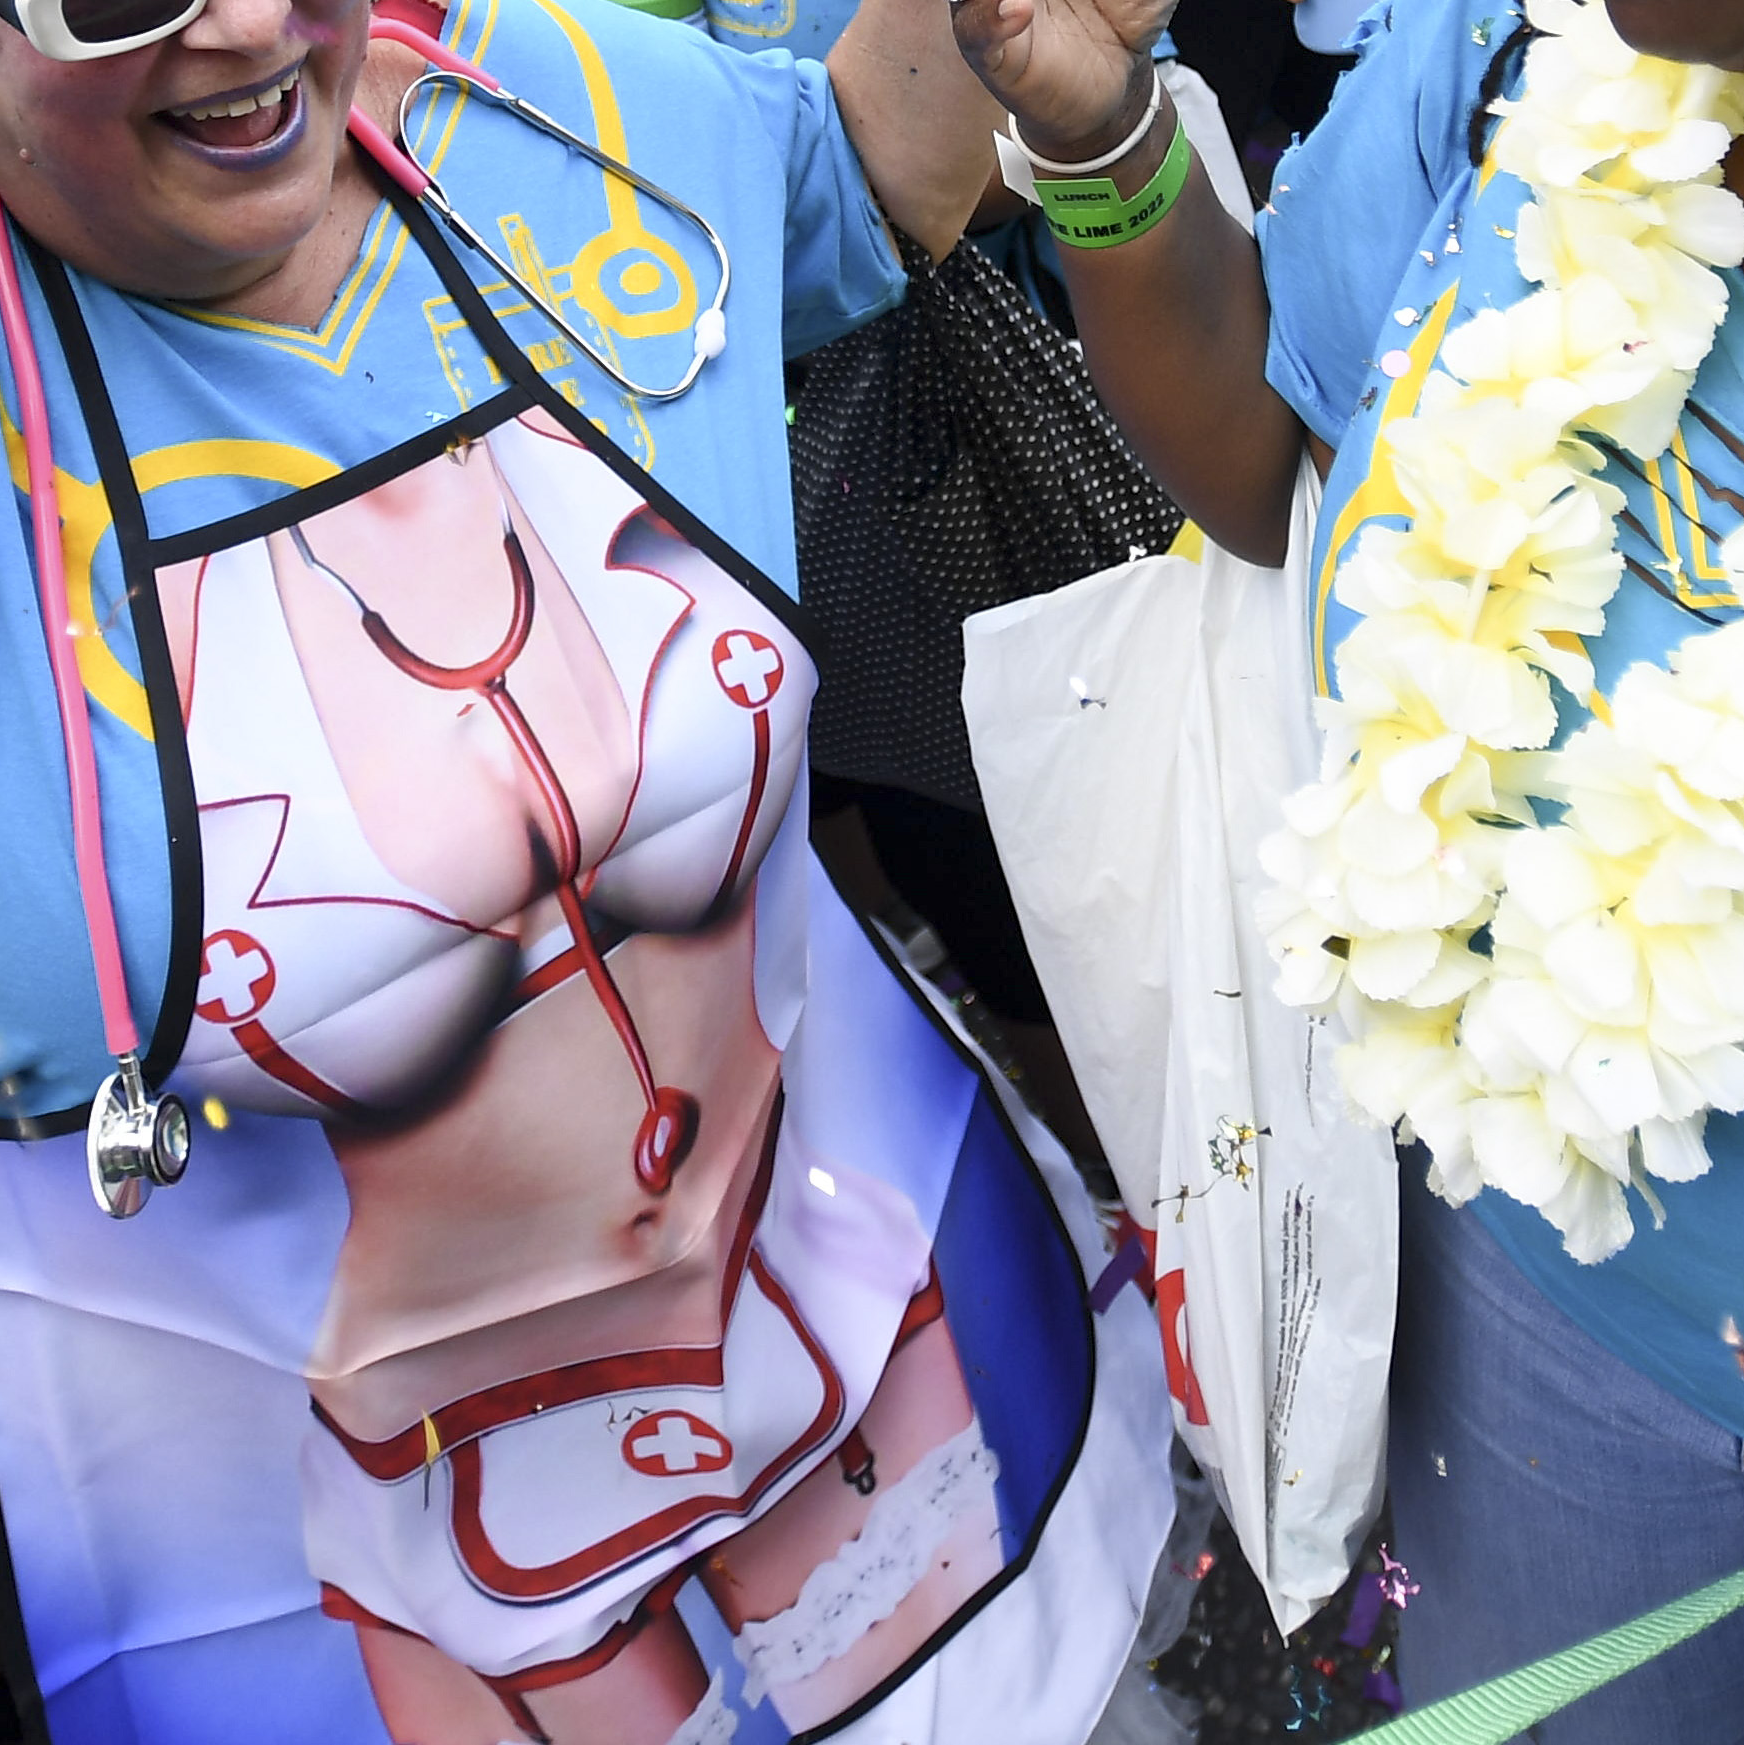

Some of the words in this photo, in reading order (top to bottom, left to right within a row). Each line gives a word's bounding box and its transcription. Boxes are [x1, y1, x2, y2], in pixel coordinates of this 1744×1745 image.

[1053, 192, 1111, 202] LUNCH
[1073, 222, 1124, 238] LIME
[1129, 192, 1166, 229] 2022
